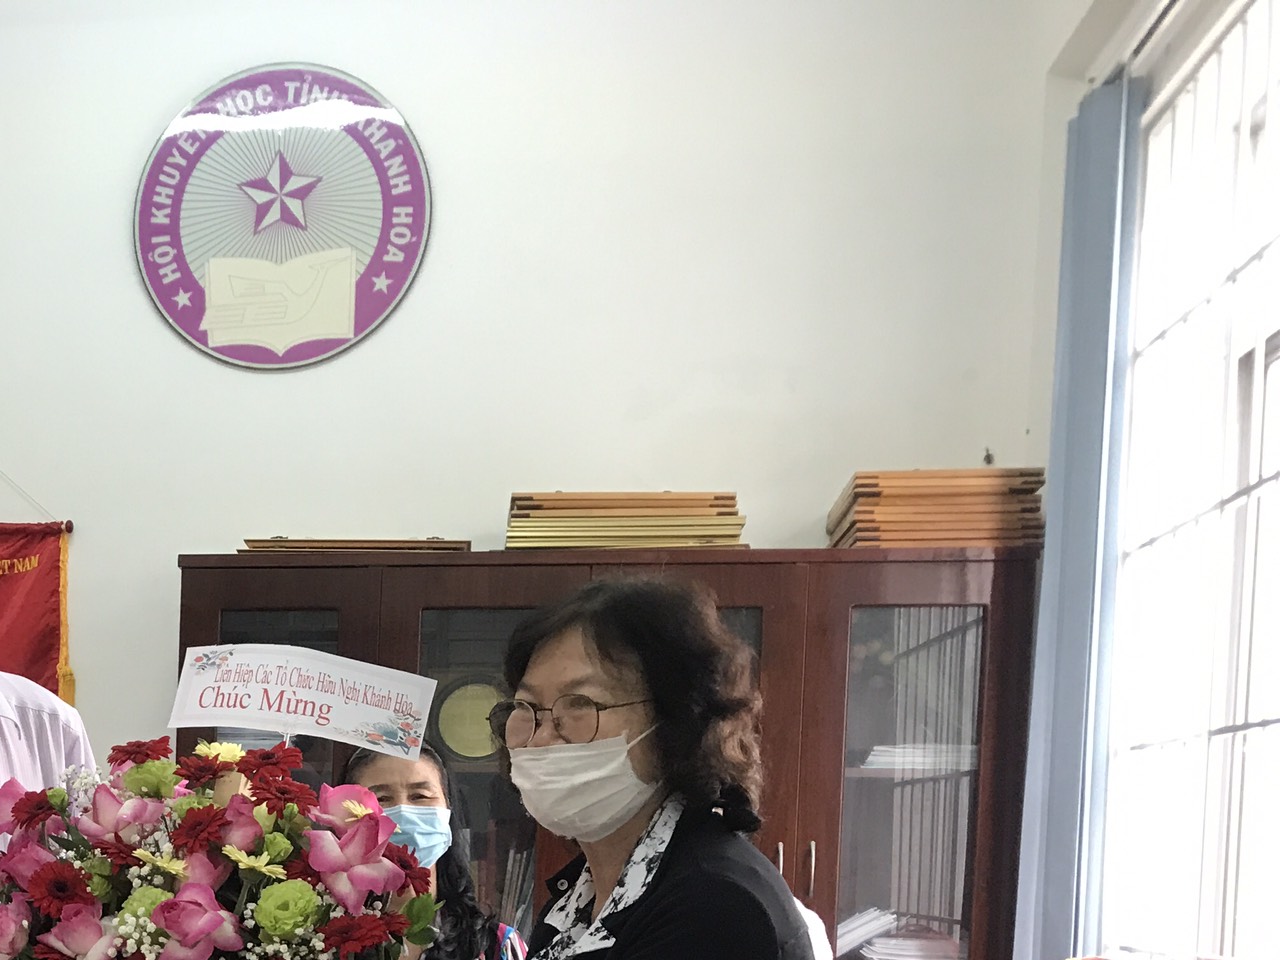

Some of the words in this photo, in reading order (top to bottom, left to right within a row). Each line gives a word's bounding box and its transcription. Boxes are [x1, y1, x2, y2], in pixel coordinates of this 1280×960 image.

[148, 235, 182, 284] HỘI
[383, 206, 418, 263] HÒA
[13, 554, 40, 574] NAM
[198, 685, 252, 710] Chúc
[258, 687, 333, 727] Mừng
[214, 663, 232, 683] Liên
[232, 663, 253, 689] Hiệp
[255, 663, 272, 685] Các
[275, 659, 289, 686] Tổ
[289, 667, 315, 690] Chức
[337, 677, 362, 706] Nghị
[361, 684, 393, 711] Khánh
[393, 692, 413, 715] Hòa
